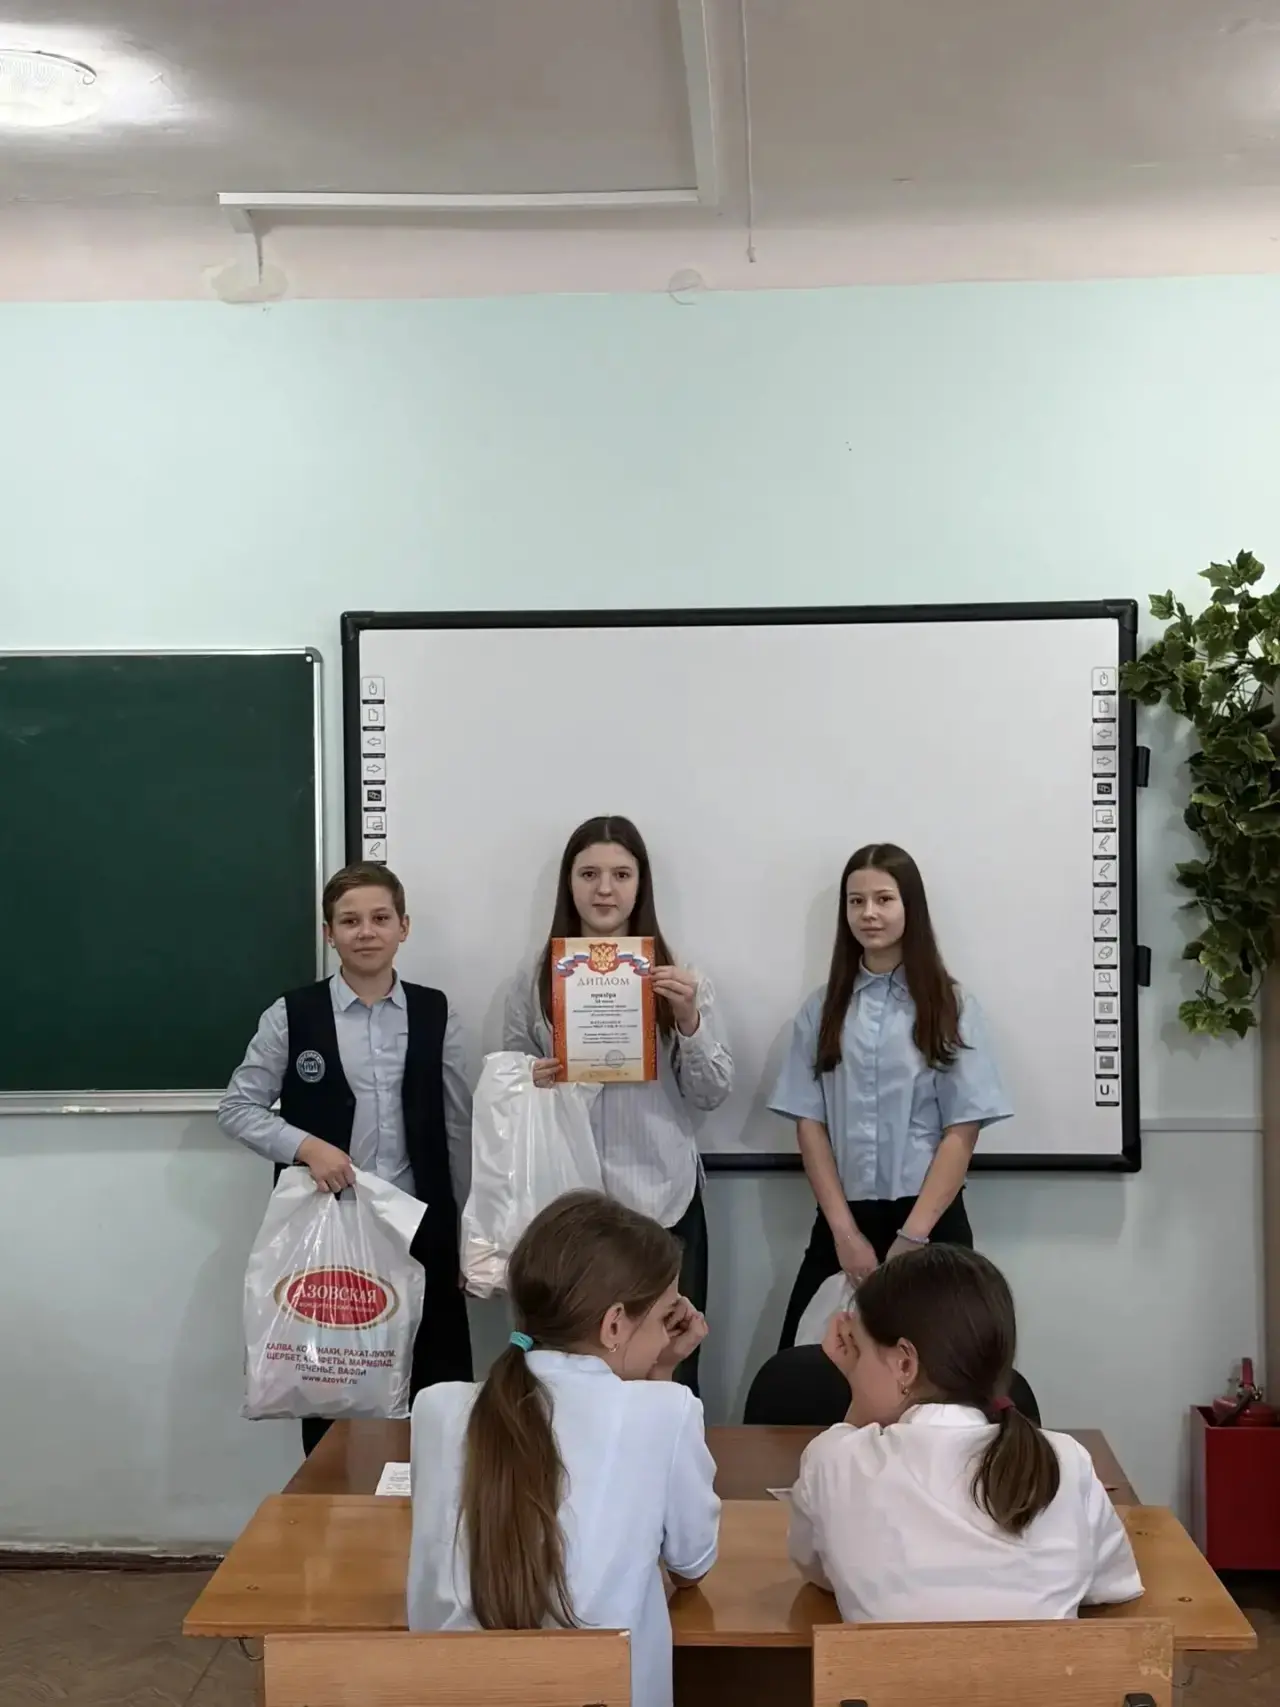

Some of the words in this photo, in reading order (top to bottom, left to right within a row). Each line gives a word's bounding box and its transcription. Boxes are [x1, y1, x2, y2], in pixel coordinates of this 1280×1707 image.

[577, 977, 630, 986] ДИПЛОМ
[295, 1283, 377, 1303] АЗОВСКАЯ
[296, 1344, 340, 1356] КОНАКИ,
[337, 1367, 367, 1377] ВАФЛИ
